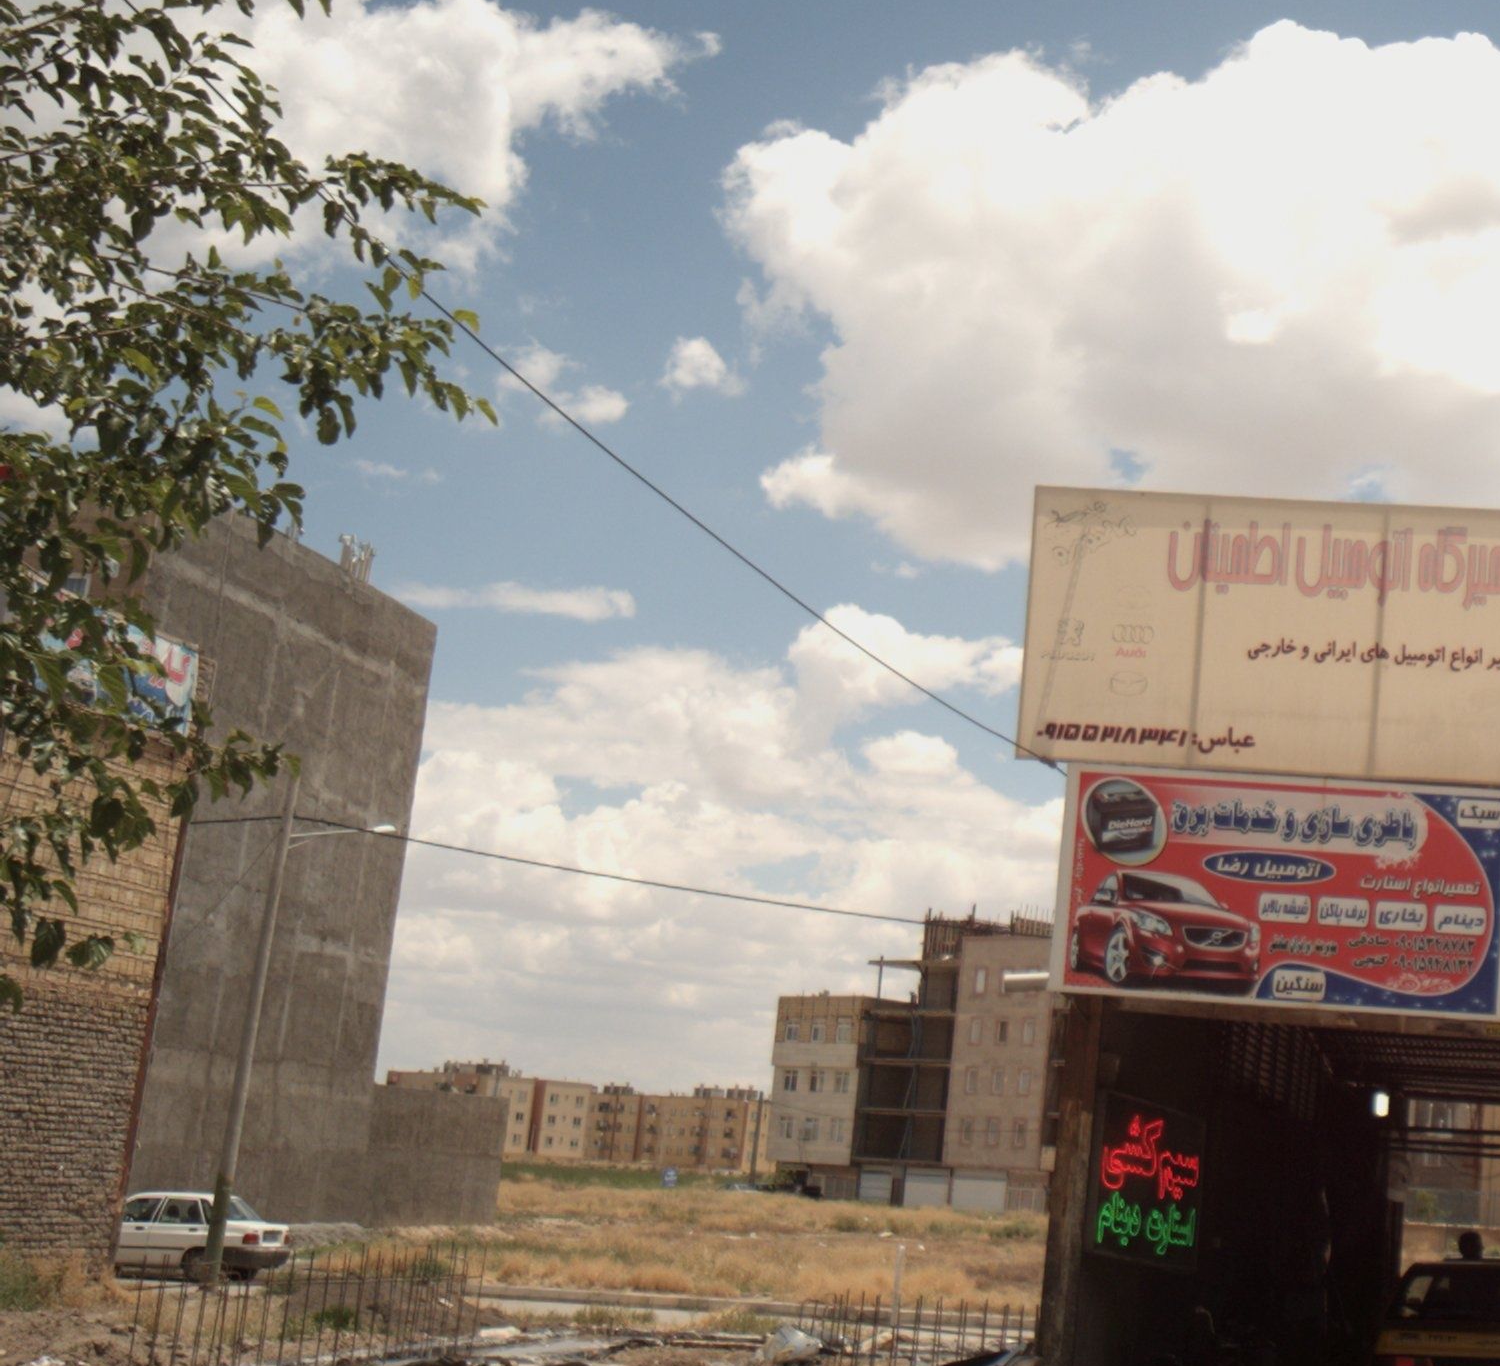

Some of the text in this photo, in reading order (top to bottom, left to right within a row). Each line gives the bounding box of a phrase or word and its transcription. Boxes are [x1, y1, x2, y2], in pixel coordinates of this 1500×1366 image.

[1167, 519, 1291, 594] اطمینان
[1296, 524, 1413, 608] اتومبیل
[1247, 637, 1298, 661] خارجی
[1300, 645, 1310, 660] و
[1313, 639, 1357, 664] ایرانی
[1360, 641, 1390, 664] های
[1393, 644, 1446, 668] اتومبیل
[1450, 647, 1483, 672] انواع
[1108, 816, 1153, 830] DieHard
[1171, 799, 1418, 850] باطری سازی و خدمات برق
[1216, 857, 1322, 880] اتومبیل رضا
[1360, 875, 1412, 892] استارت
[1345, 905, 1368, 923] برف
[1378, 910, 1424, 927] بخاری
[1437, 913, 1485, 930] دینام
[1276, 973, 1324, 995] سنگین
